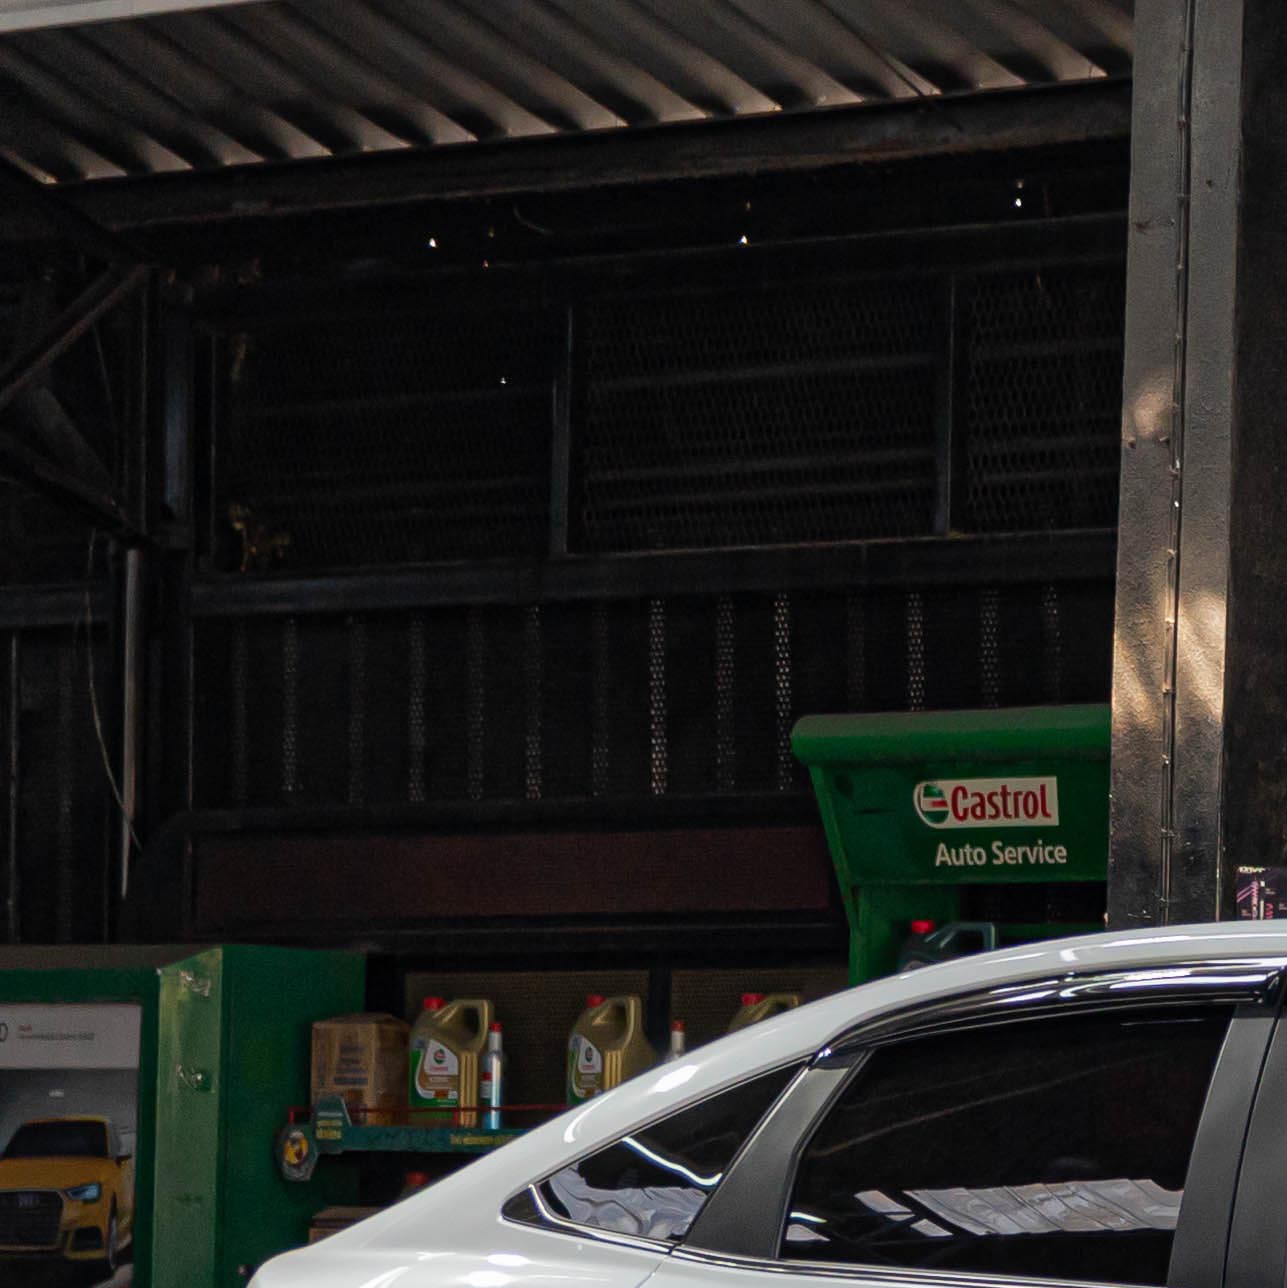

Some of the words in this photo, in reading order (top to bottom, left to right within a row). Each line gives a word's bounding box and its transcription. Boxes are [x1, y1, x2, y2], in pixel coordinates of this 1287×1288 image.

[950, 783, 1052, 821] Castrol
[934, 840, 987, 868] Auto
[991, 839, 1068, 866] Service
